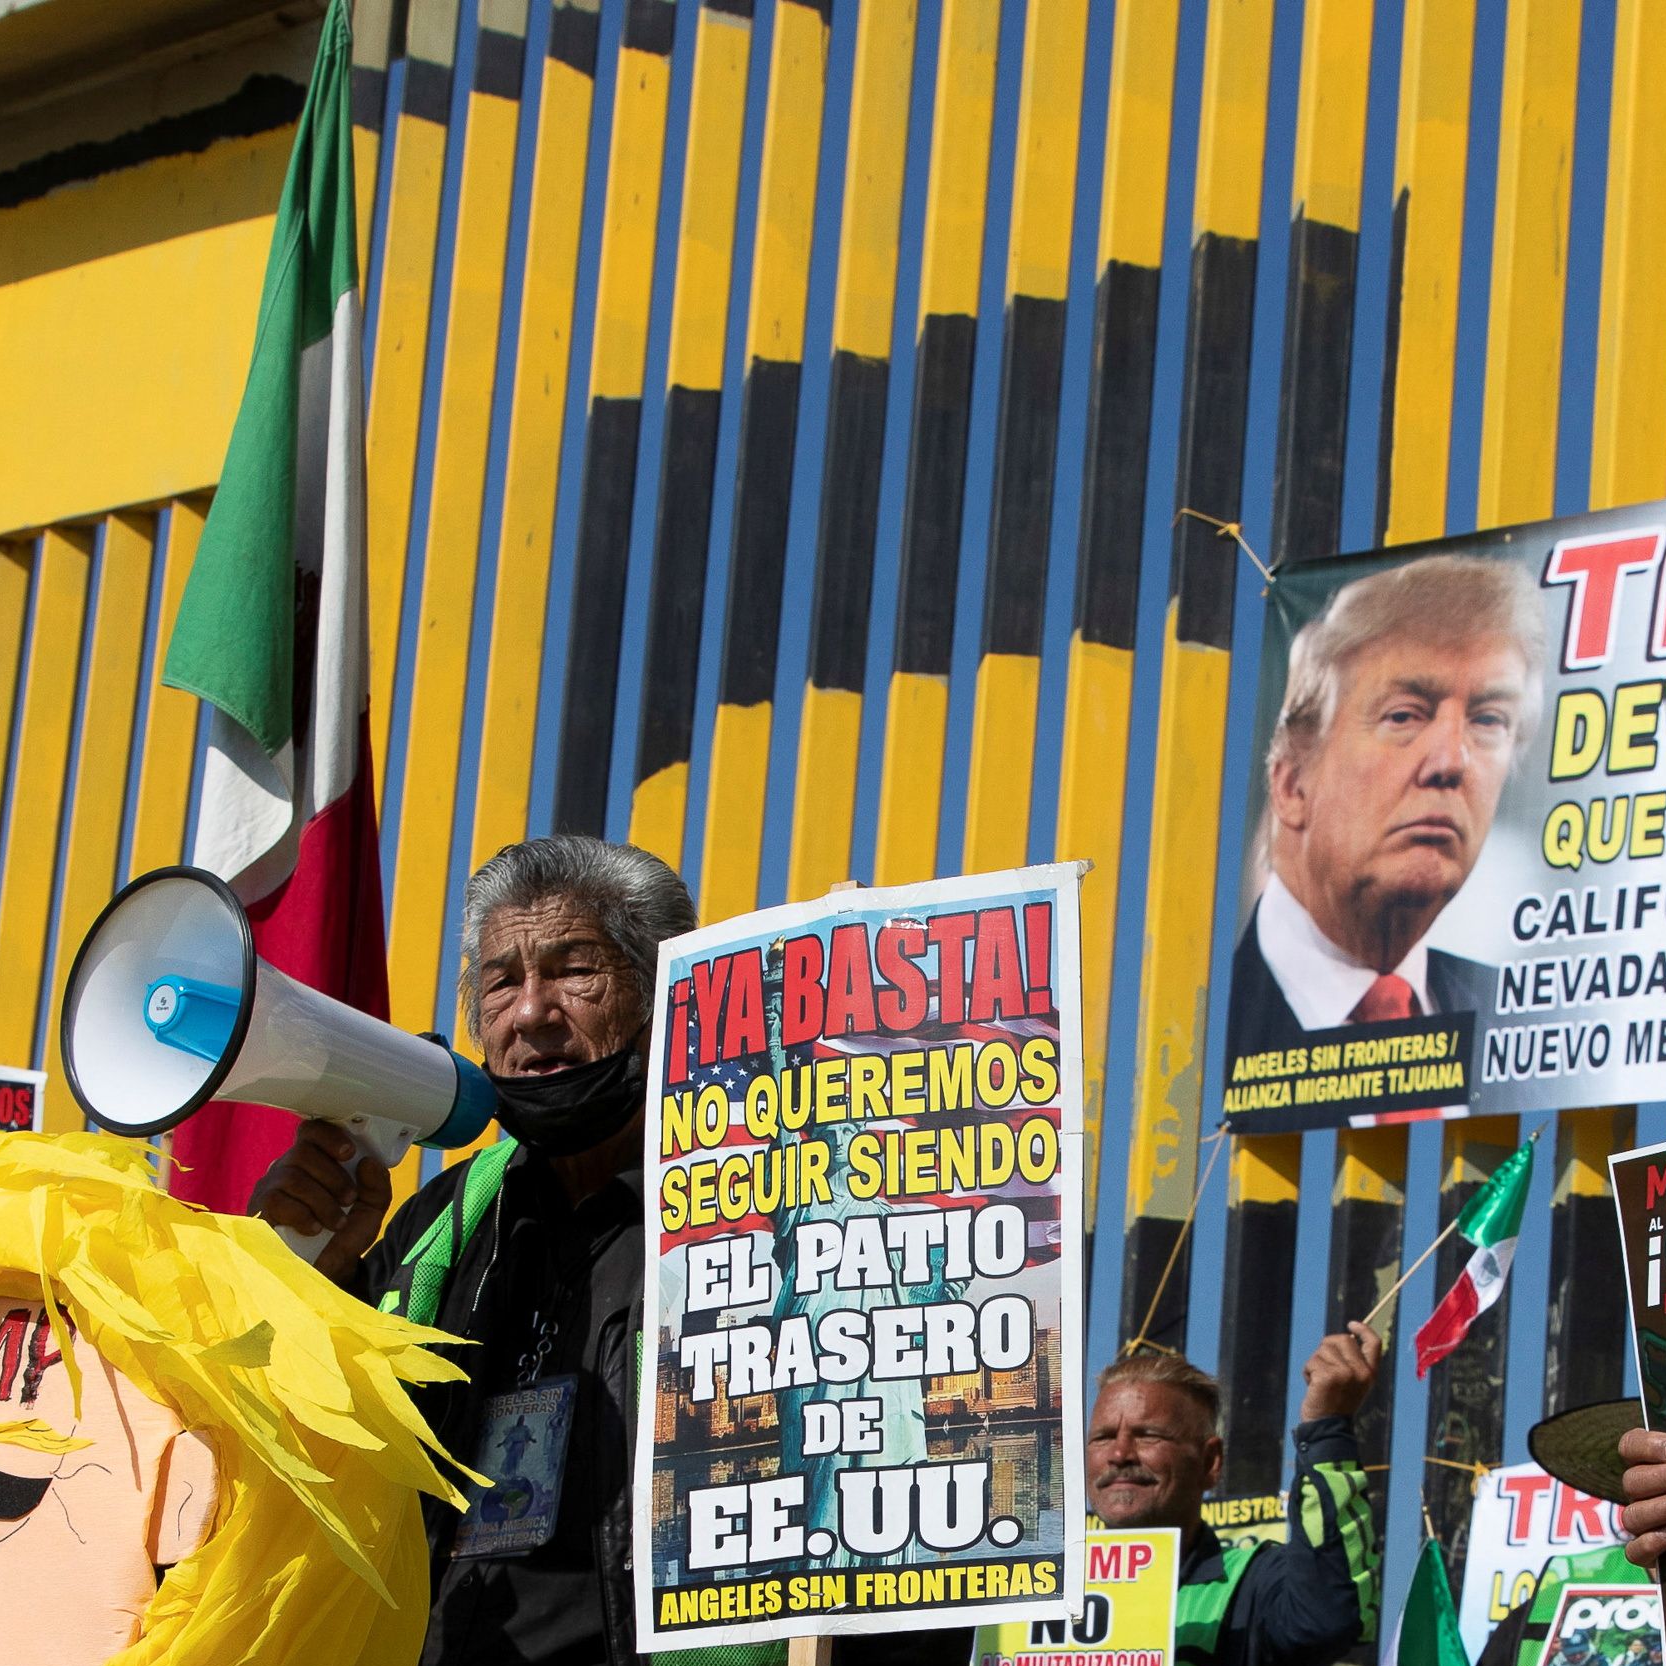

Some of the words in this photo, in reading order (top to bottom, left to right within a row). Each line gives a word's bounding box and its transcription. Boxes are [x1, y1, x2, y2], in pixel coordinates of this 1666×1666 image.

[668, 948, 765, 1086] ¡YA
[783, 902, 1054, 1045] BASTA!
[1223, 1081, 1291, 1113] ALIANZA
[1294, 1070, 1384, 1105] MIGRANTE
[1387, 1062, 1464, 1094] TIJUANA
[1232, 1048, 1308, 1081] ANGELES
[1311, 1044, 1341, 1072] SIN
[1343, 1032, 1447, 1068] FRONTERAS
[1485, 1024, 1611, 1076] NUEVO
[662, 1084, 729, 1156] NO
[745, 1037, 1059, 1139] QUEREMOS
[660, 1139, 832, 1232] SEGUIR
[847, 1116, 1057, 1198] SIENDO
[685, 1234, 771, 1316] EL
[796, 1204, 1029, 1286] PATIO
[1649, 1217, 1664, 1232] AL
[681, 1295, 1034, 1406] TRASERO
[803, 1398, 883, 1458] DE
[688, 1460, 1026, 1572] EE.UU.
[660, 1575, 781, 1627] ANGELES
[790, 1570, 846, 1611] SIN
[855, 1560, 1057, 1608] FRONTERAS
